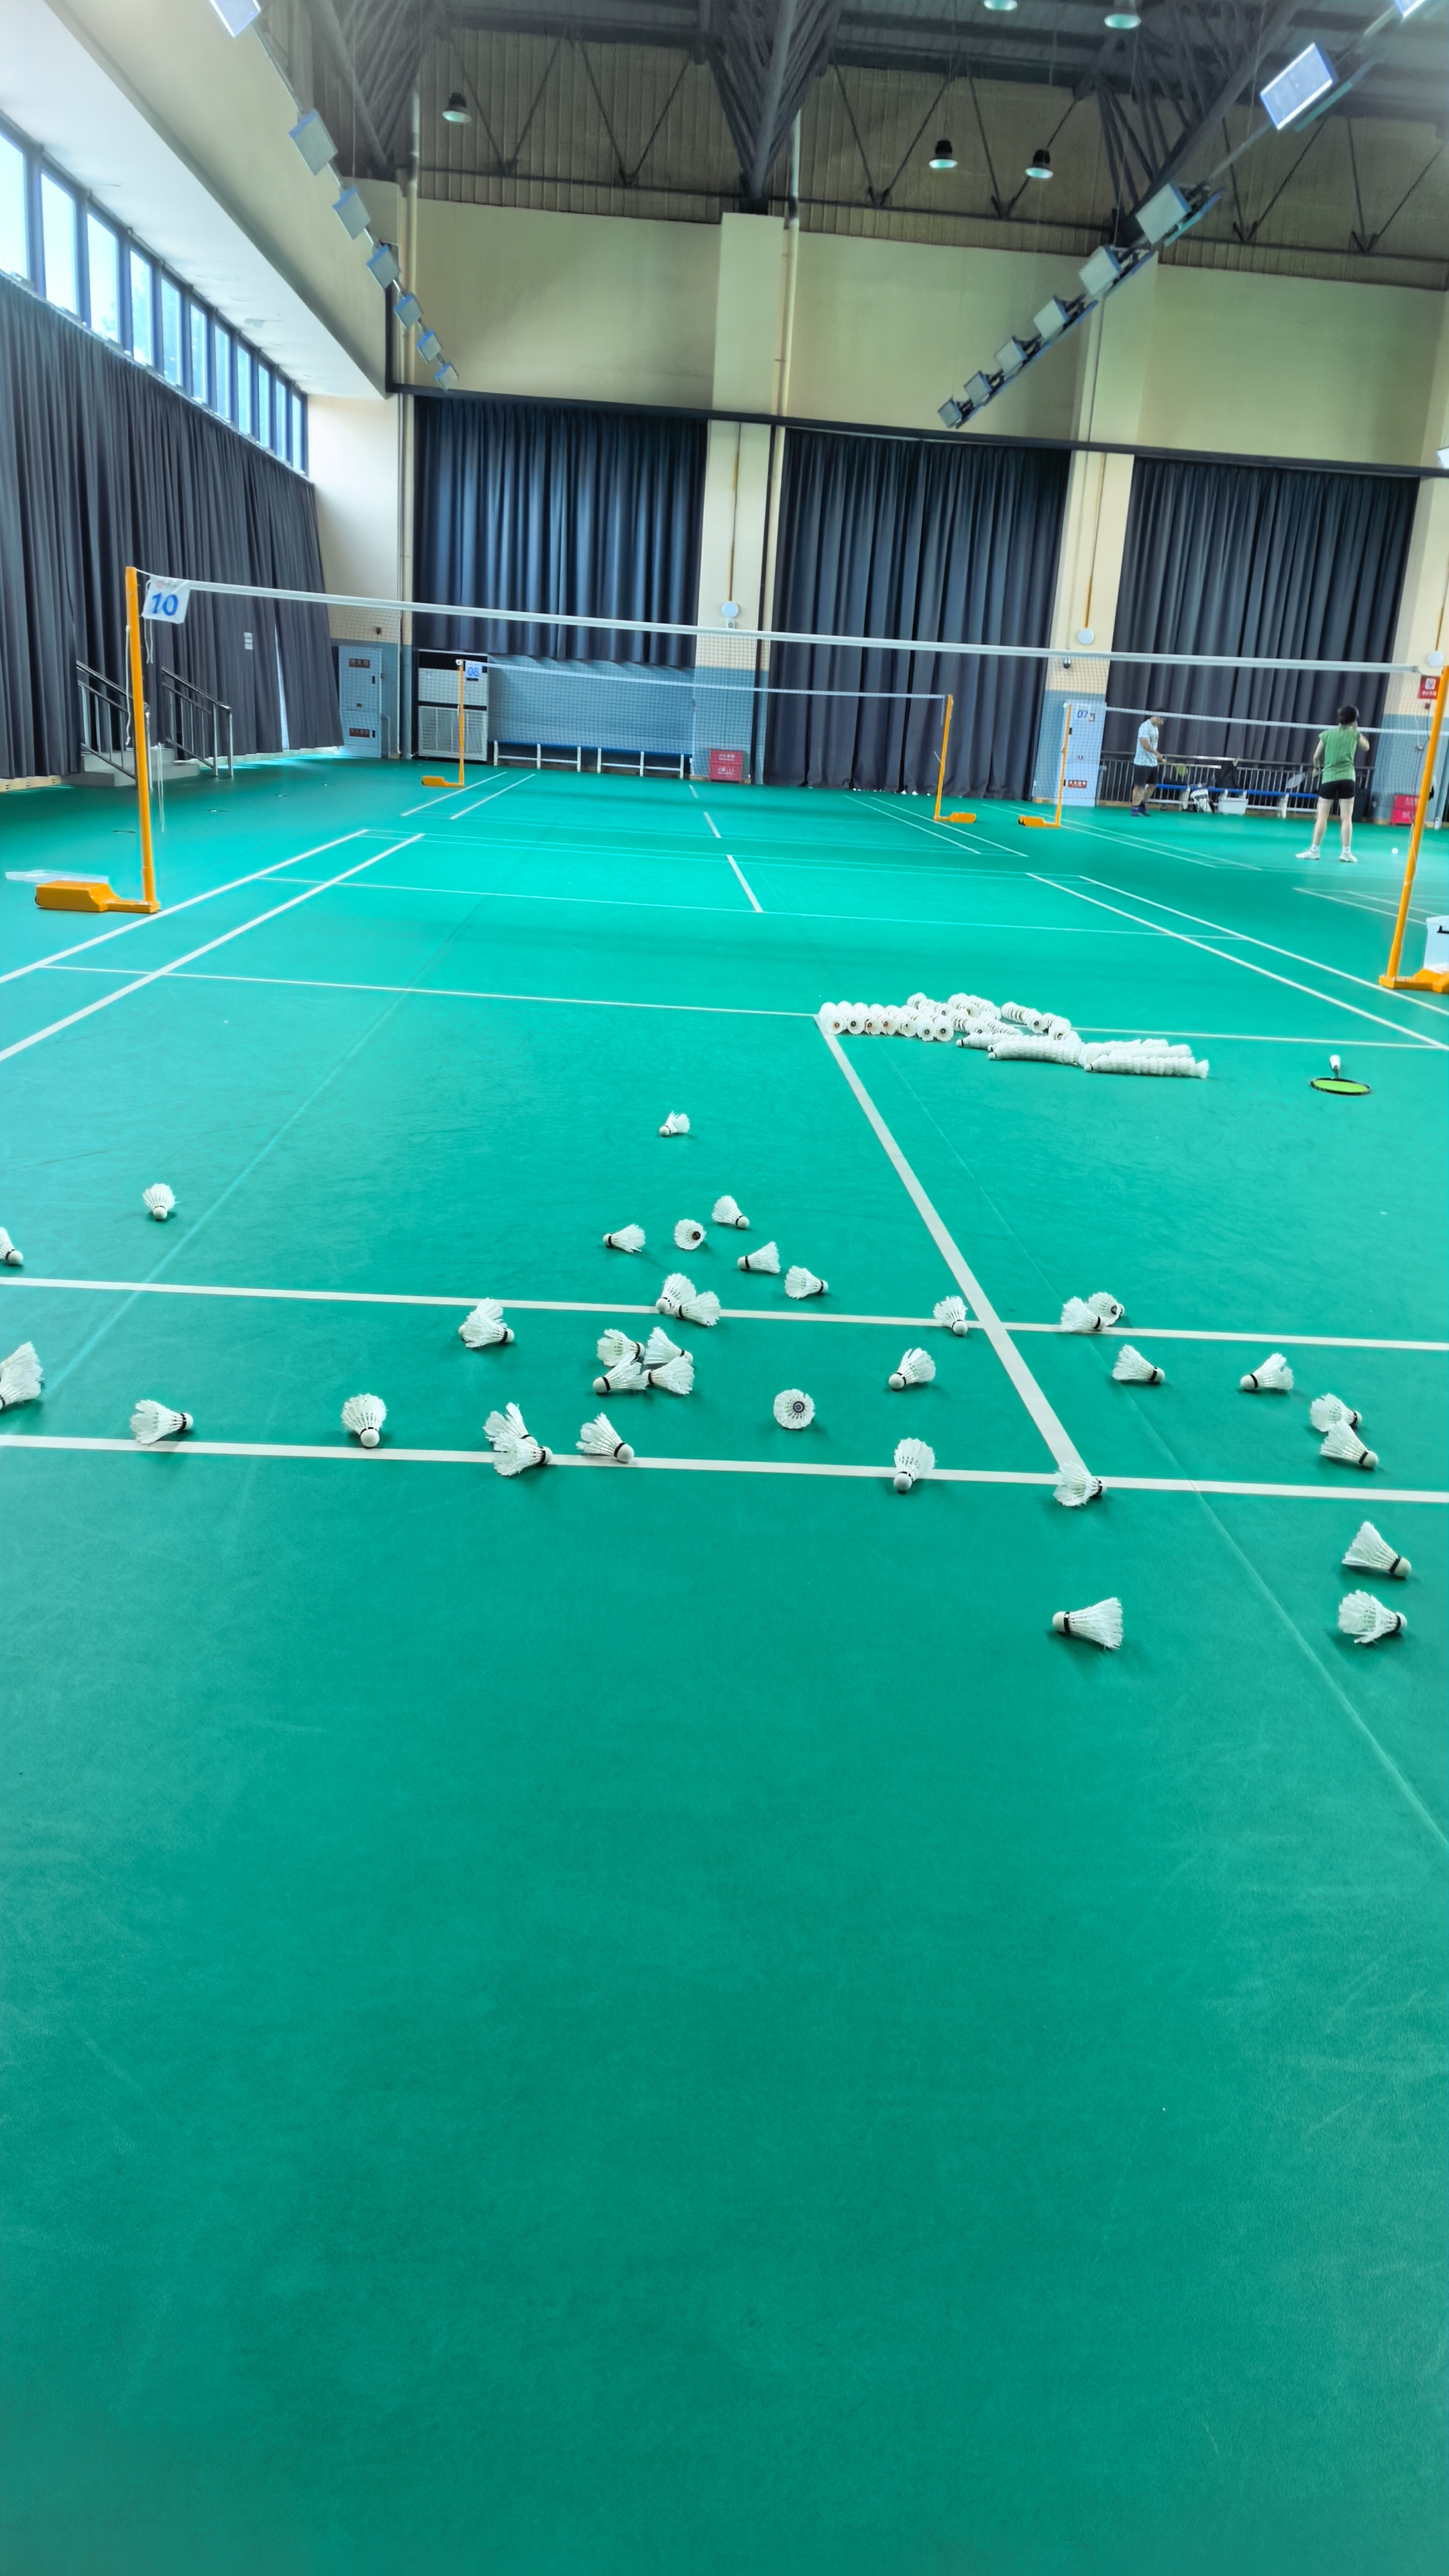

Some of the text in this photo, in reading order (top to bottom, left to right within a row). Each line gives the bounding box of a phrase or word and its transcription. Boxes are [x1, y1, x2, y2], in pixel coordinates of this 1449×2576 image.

[152, 592, 178, 616] 10
[468, 667, 479, 677] 08
[1077, 709, 1088, 718] 07
